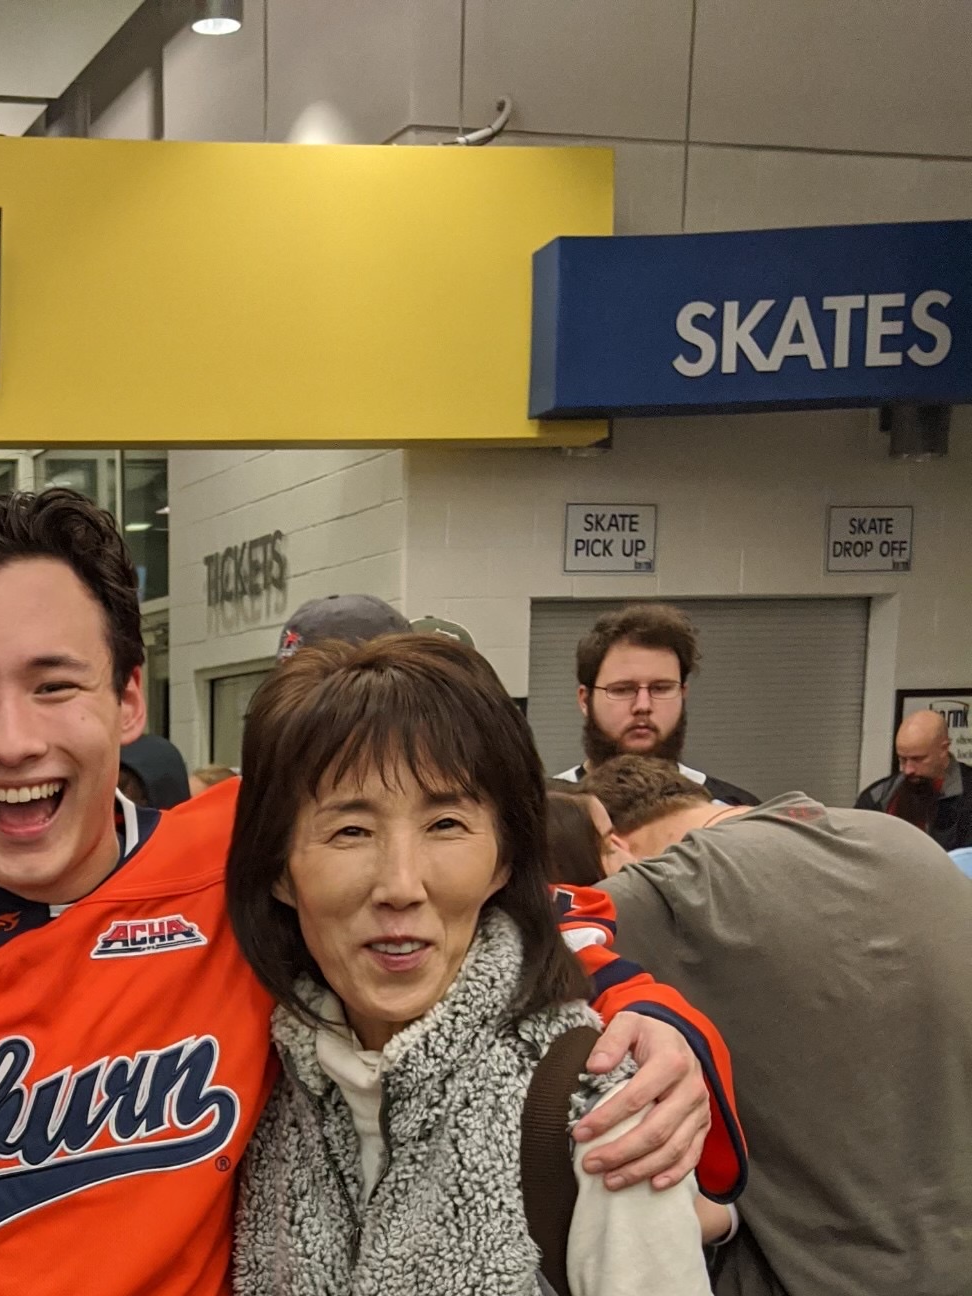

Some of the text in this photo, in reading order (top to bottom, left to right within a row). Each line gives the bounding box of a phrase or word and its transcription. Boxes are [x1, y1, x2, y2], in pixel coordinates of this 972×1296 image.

[672, 290, 953, 378] SKATES
[584, 513, 639, 532] SKATE
[849, 517, 894, 535] SKATE
[574, 539, 646, 557] PICK UP
[833, 541, 908, 557] DROP OFF
[203, 529, 287, 607] TICKETS
[100, 918, 196, 949] ACHA
